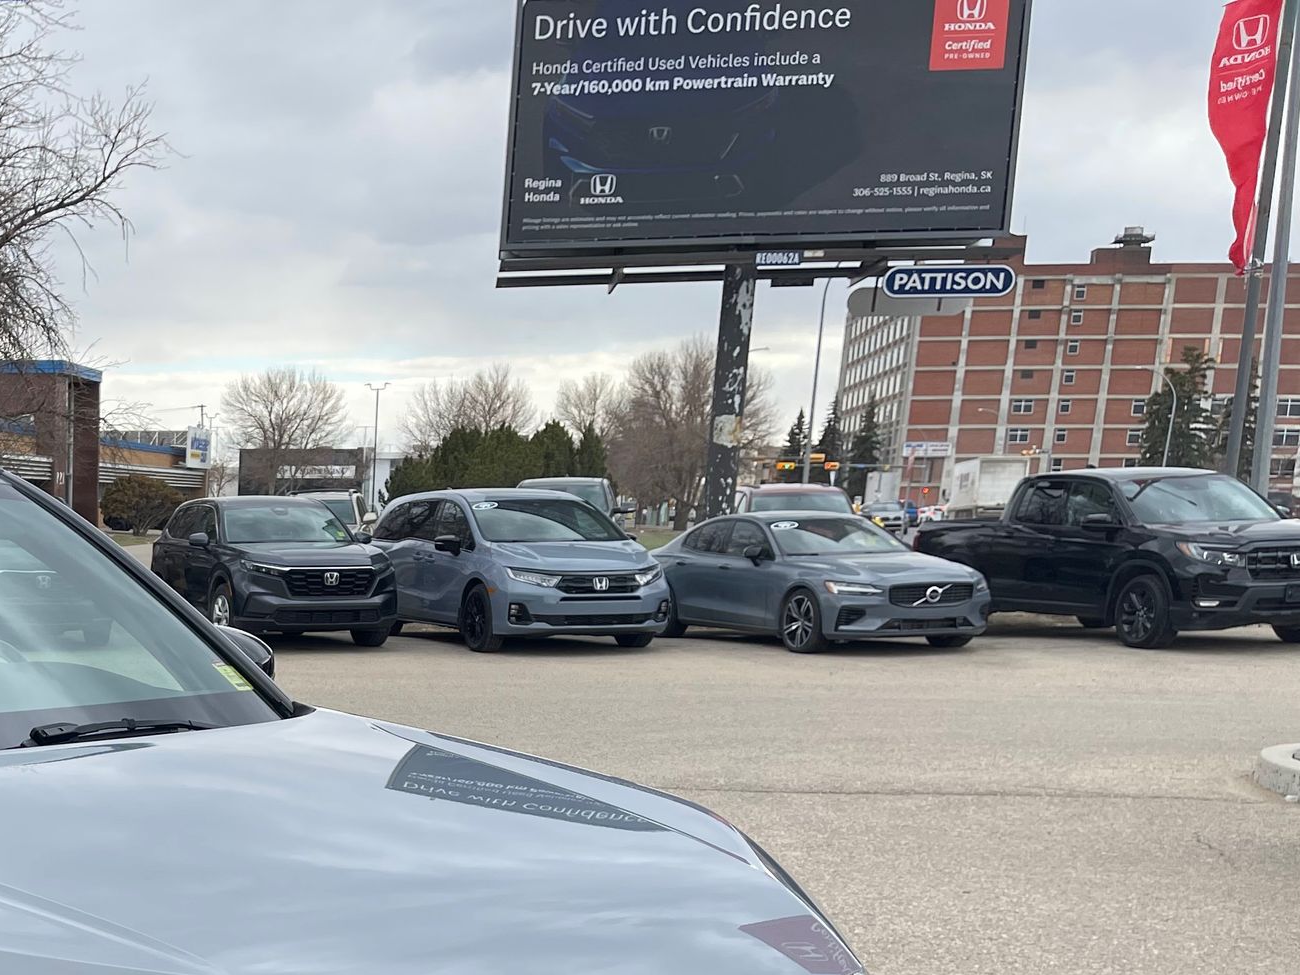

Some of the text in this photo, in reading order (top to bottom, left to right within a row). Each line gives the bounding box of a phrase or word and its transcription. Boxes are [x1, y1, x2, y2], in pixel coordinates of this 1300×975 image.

[534, 4, 851, 40] Drive with Confidence
[944, 22, 996, 31] HONDA
[945, 39, 992, 52] Certified
[944, 52, 990, 60] PRE-OWNED
[532, 51, 821, 75] Honda Certified Used Vehicles include a
[531, 72, 835, 96] 7-Year/160,000 km Powertrain Warranty
[880, 173, 898, 182] 889
[899, 172, 927, 181] Broad
[944, 170, 978, 182] Regina,
[981, 170, 993, 179] SK
[524, 178, 562, 190] Regina
[524, 191, 560, 202] Honda
[853, 186, 912, 197] 306-525-1555
[920, 184, 991, 197] reginahonda.ca
[580, 196, 624, 205] HONDA
[893, 272, 1005, 290] PATTISON
